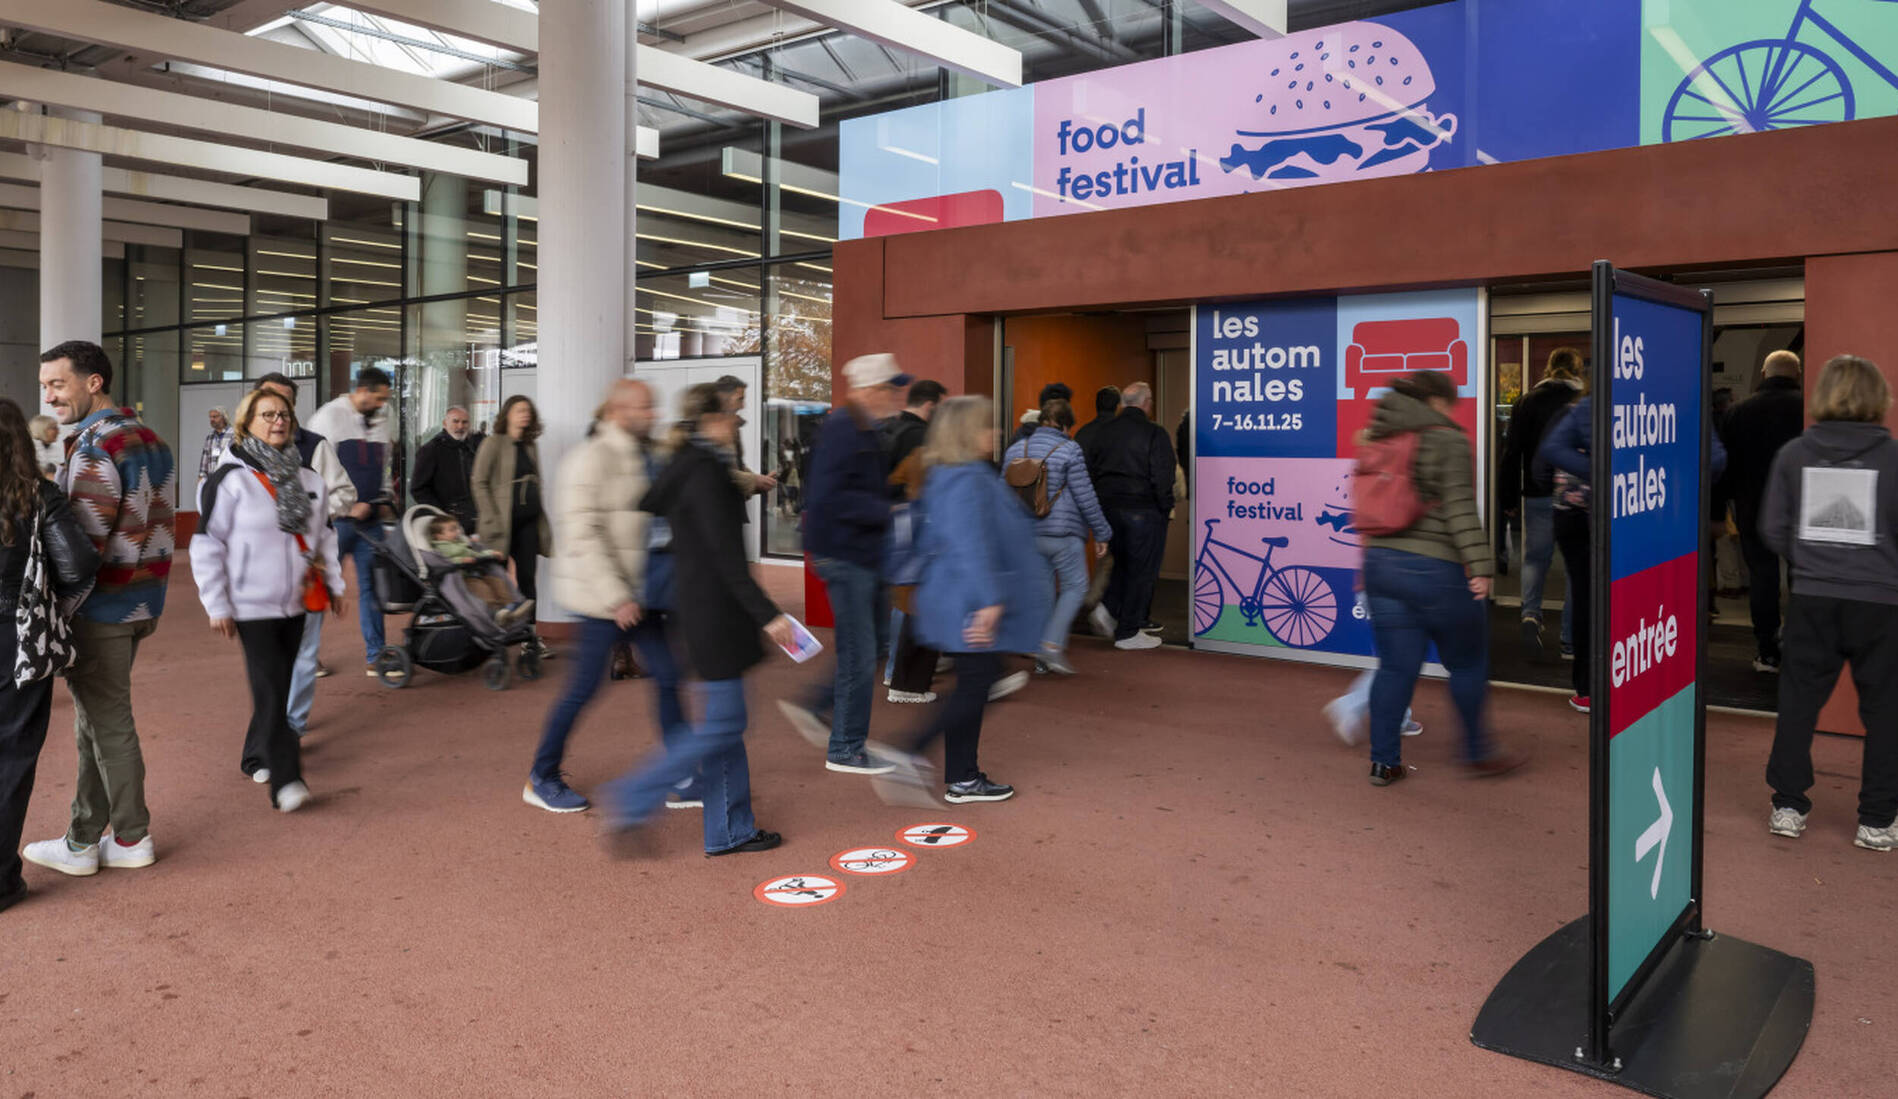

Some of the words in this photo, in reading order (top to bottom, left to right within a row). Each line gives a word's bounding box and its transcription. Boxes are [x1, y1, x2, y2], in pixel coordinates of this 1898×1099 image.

[1057, 107, 1145, 156] food
[1057, 148, 1201, 203] festival
[1213, 310, 1260, 339] les
[1613, 317, 1644, 381] les
[1212, 342, 1321, 371] autom
[1212, 372, 1304, 403] nales
[1613, 392, 1677, 449] autom
[1227, 476, 1275, 496] food
[1227, 500, 1304, 521] festival
[1613, 454, 1667, 519] nales
[1612, 604, 1678, 688] entrée
